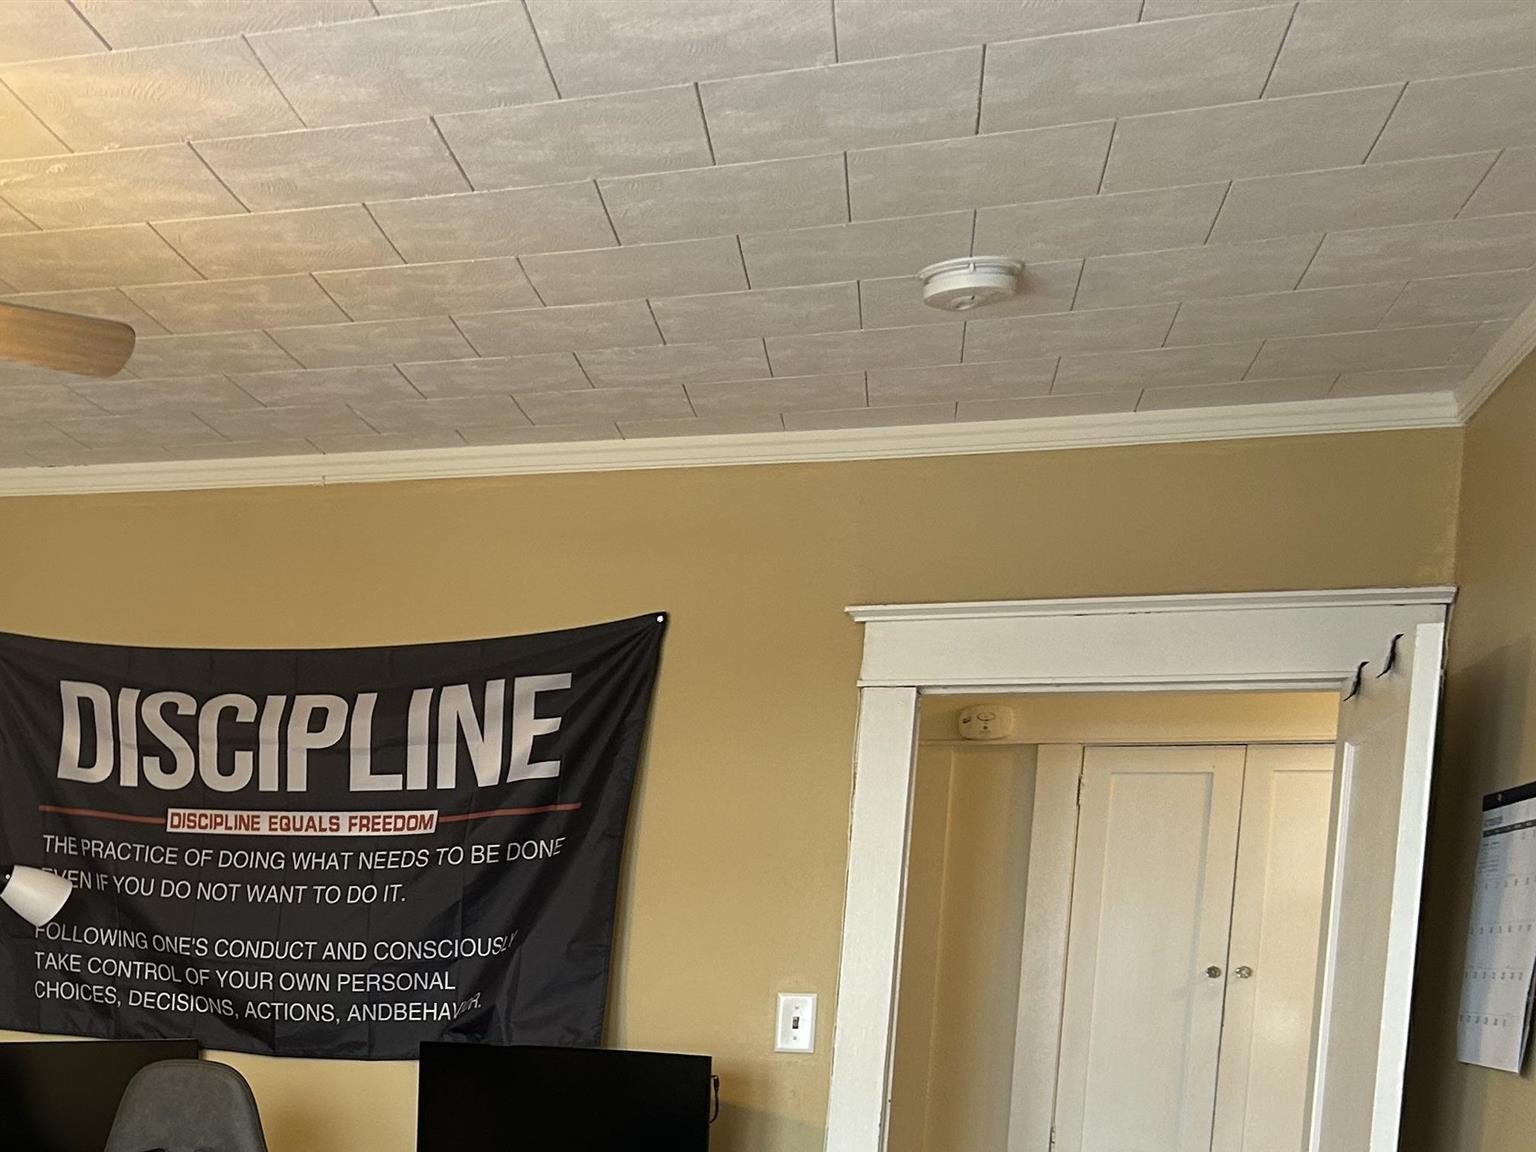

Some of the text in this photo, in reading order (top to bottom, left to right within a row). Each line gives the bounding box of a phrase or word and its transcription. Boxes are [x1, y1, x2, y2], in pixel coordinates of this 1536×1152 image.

[57, 673, 572, 792] DISCIPLINE
[169, 812, 435, 833] DISCIPLINE EQUALS FREEDOM
[43, 834, 566, 870] THE PRACTICE OF DOING WHAT NEEDS TO BE DONE
[41, 867, 406, 904] EN IF YOU DO NOT WANT TO DO IT.
[35, 923, 148, 949] FOLLOWING
[152, 934, 208, 957] ONE'S
[214, 939, 317, 960] CONDUCT
[322, 941, 367, 960] AND
[34, 951, 456, 992] TAKE CONTROL OF YOUR OWN PERSONAL
[34, 981, 121, 1008] CHOICES,
[128, 990, 240, 1019] DECISIONS,
[244, 1001, 340, 1025] ACTIONS,
